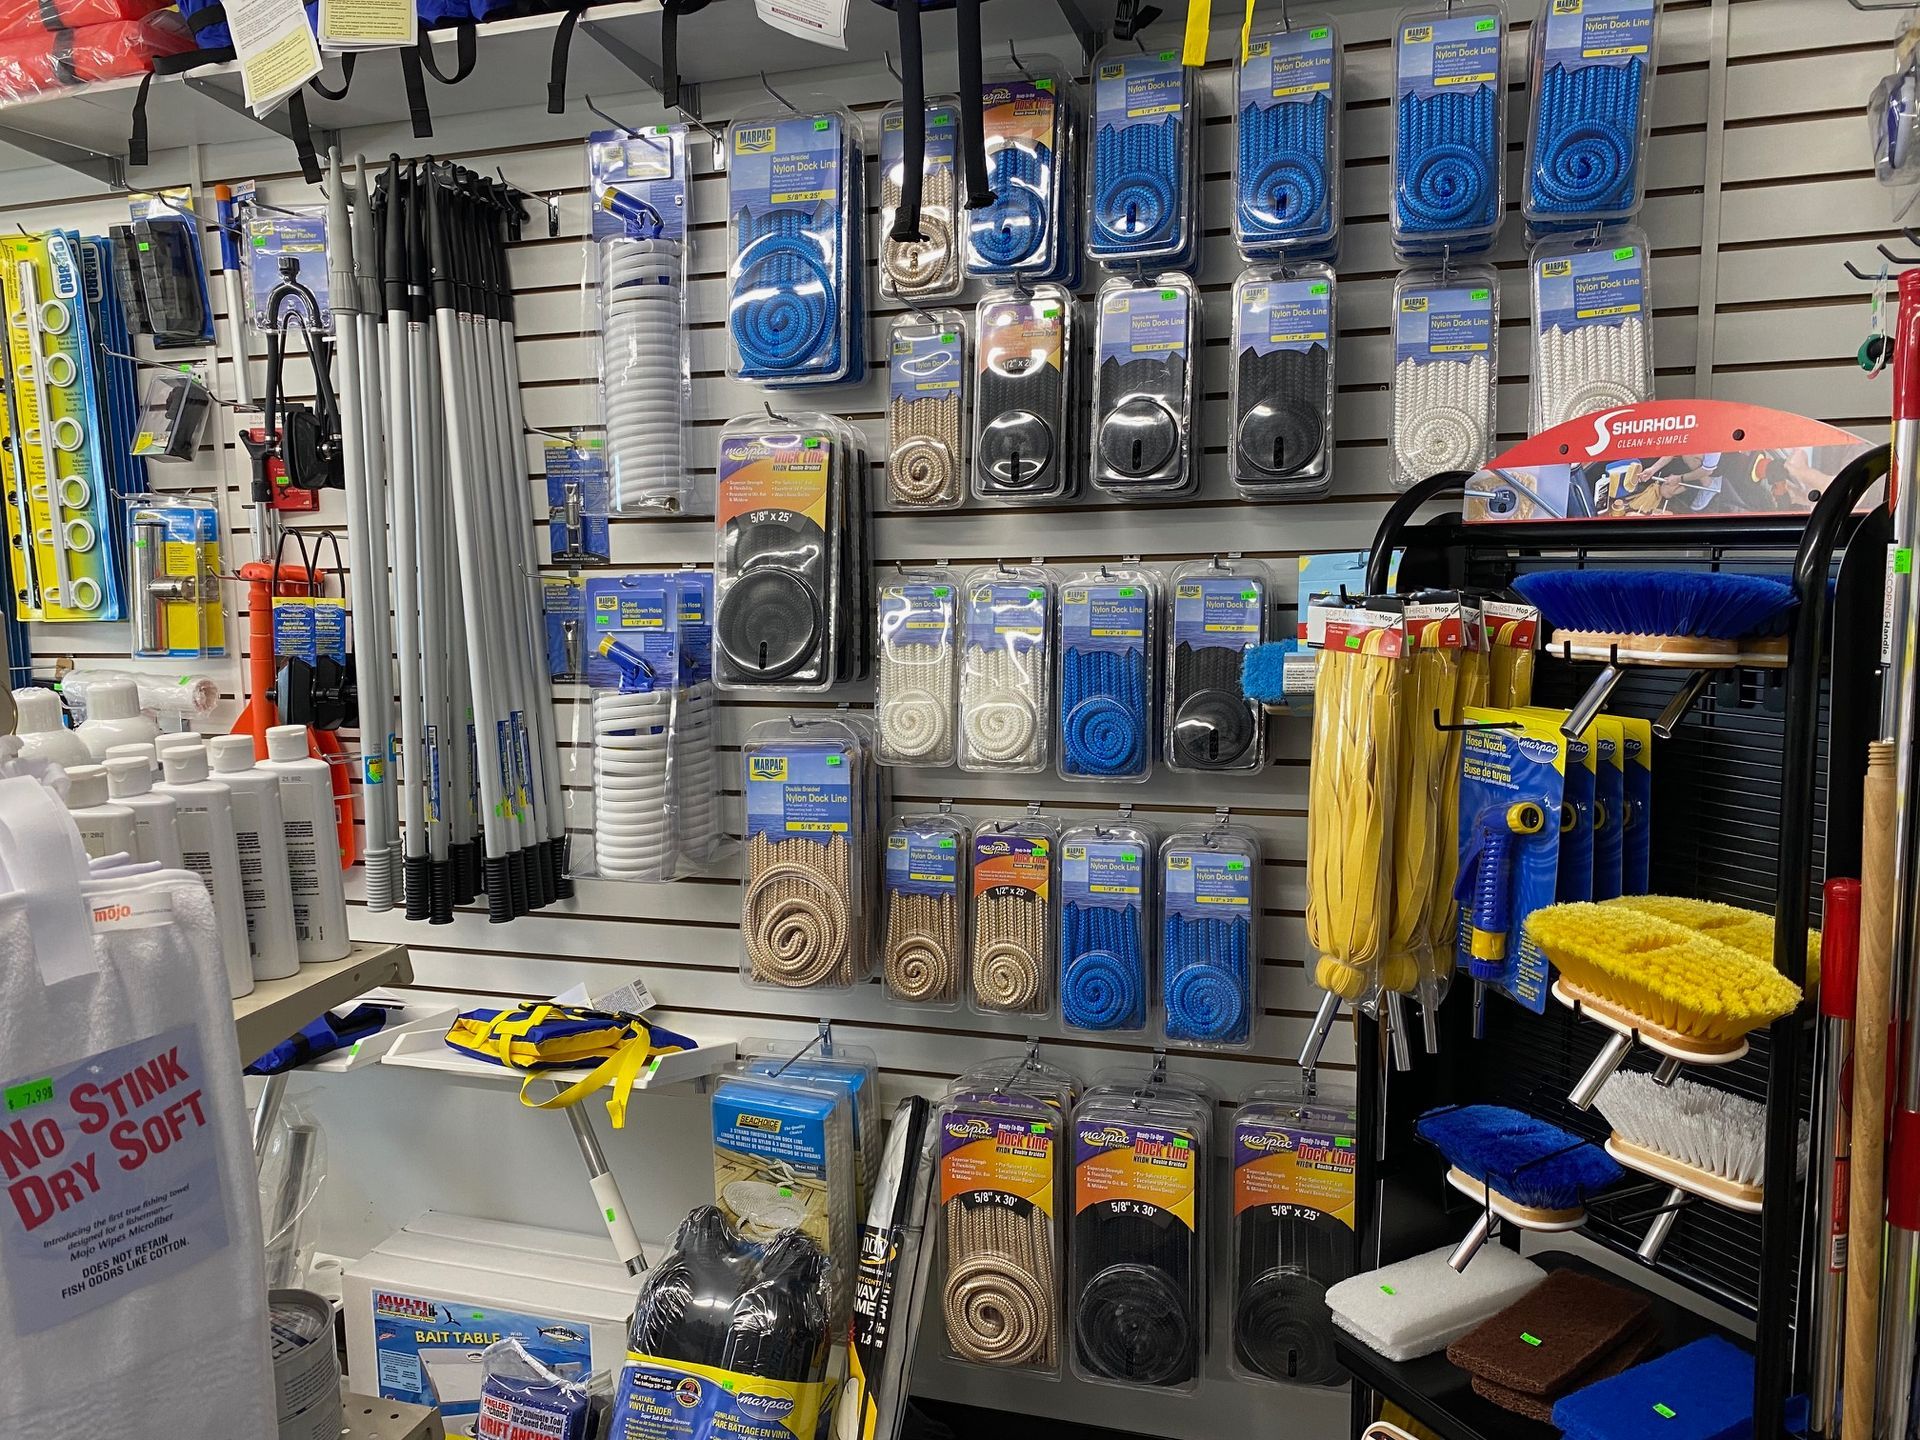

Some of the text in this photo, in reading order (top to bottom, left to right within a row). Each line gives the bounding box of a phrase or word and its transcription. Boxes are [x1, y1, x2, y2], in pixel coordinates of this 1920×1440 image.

[1585, 18, 1649, 31] Nylon Dock Line
[1407, 28, 1430, 38] MARPAC
[1435, 46, 1496, 59] Nylon Dock Line
[1274, 62, 1294, 72] Nylon
[1296, 60, 1313, 69] Dock
[1128, 80, 1181, 94] Nylon Dock Line
[740, 129, 771, 144] MARPAC
[773, 160, 836, 175] Nylon Dock Line
[1545, 262, 1568, 272] MARPAC
[1576, 278, 1640, 293] Nylon Dock Line
[1404, 298, 1426, 307] MARPAC
[1272, 310, 1291, 318] Nylon
[1293, 308, 1310, 316] Dock
[1431, 320, 1450, 330] Nylon
[1452, 318, 1472, 326] Dock
[1002, 359, 1017, 368] 1/2"
[1617, 434, 1689, 448] CLEAN-N-SIMPLE
[750, 511, 793, 523] 5/8" 25'
[1180, 585, 1200, 594] MARPAC
[1092, 606, 1143, 614] Nylon Dock Line
[1206, 600, 1225, 609] Nylon
[1405, 604, 1449, 614] THIRSTY Mop
[1380, 614, 1392, 622] Mop
[1882, 621, 1890, 655] Handle
[1466, 734, 1506, 752] Hose Nozzle
[1520, 738, 1559, 755] marpac
[754, 758, 784, 770] MARPAC
[1464, 763, 1511, 784] Buse de tuyau
[786, 794, 848, 803] Nylon Dock Line
[1090, 863, 1107, 871] Nylon
[1196, 872, 1214, 881] Nylon
[1234, 874, 1249, 882] Line
[996, 887, 1026, 896] 1/2" 25'
[94, 904, 131, 923] mojo
[8, 1098, 14, 1111] $
[0, 1046, 190, 1181] NO STINK
[740, 1115, 780, 1128] SEACHOICE
[998, 1123, 1024, 1132] Ready-To-Use
[946, 1122, 992, 1138] marpac
[997, 1130, 1050, 1151] Dock Line
[1080, 1130, 1130, 1146] marpac
[1240, 1134, 1292, 1150] marpac
[1300, 1136, 1329, 1146] Ready-To-Use
[1135, 1138, 1190, 1160] Dock Line
[1298, 1144, 1356, 1166] Dock Line
[7, 1088, 206, 1232] DRY SOFT
[974, 1192, 1018, 1206] 5/8" x 30'
[43, 1183, 190, 1249] Introducing the first true fishing towel
[1111, 1201, 1157, 1216] 5/8" x 30'
[1271, 1205, 1320, 1220] 5/8" x 25'
[68, 1230, 104, 1250] designed
[106, 1223, 116, 1234] for
[70, 1213, 174, 1262] Mojo Wipes Microfiber
[82, 1234, 169, 1279] DOES NOT RETAIN
[61, 1237, 190, 1300] FISH ODORS LIKE COTTON.
[378, 1294, 428, 1310] MULTI
[416, 1330, 500, 1345] BAIT TABLE
[860, 1333, 872, 1345] 1.8
[630, 1394, 656, 1404] INFLATABLE
[685, 1383, 696, 1402] 2
[484, 1396, 510, 1412] ANGLERS
[628, 1402, 672, 1416] VINYL FENDER
[738, 1393, 794, 1413] marpac
[512, 1406, 564, 1426] The Ultimate Tool
[714, 1410, 740, 1423] GONFLABLE
[480, 1416, 510, 1439] DRIFT
[512, 1414, 563, 1434] for Speed Control
[712, 1418, 791, 1440] PARE BATTAGE EN VINYL
